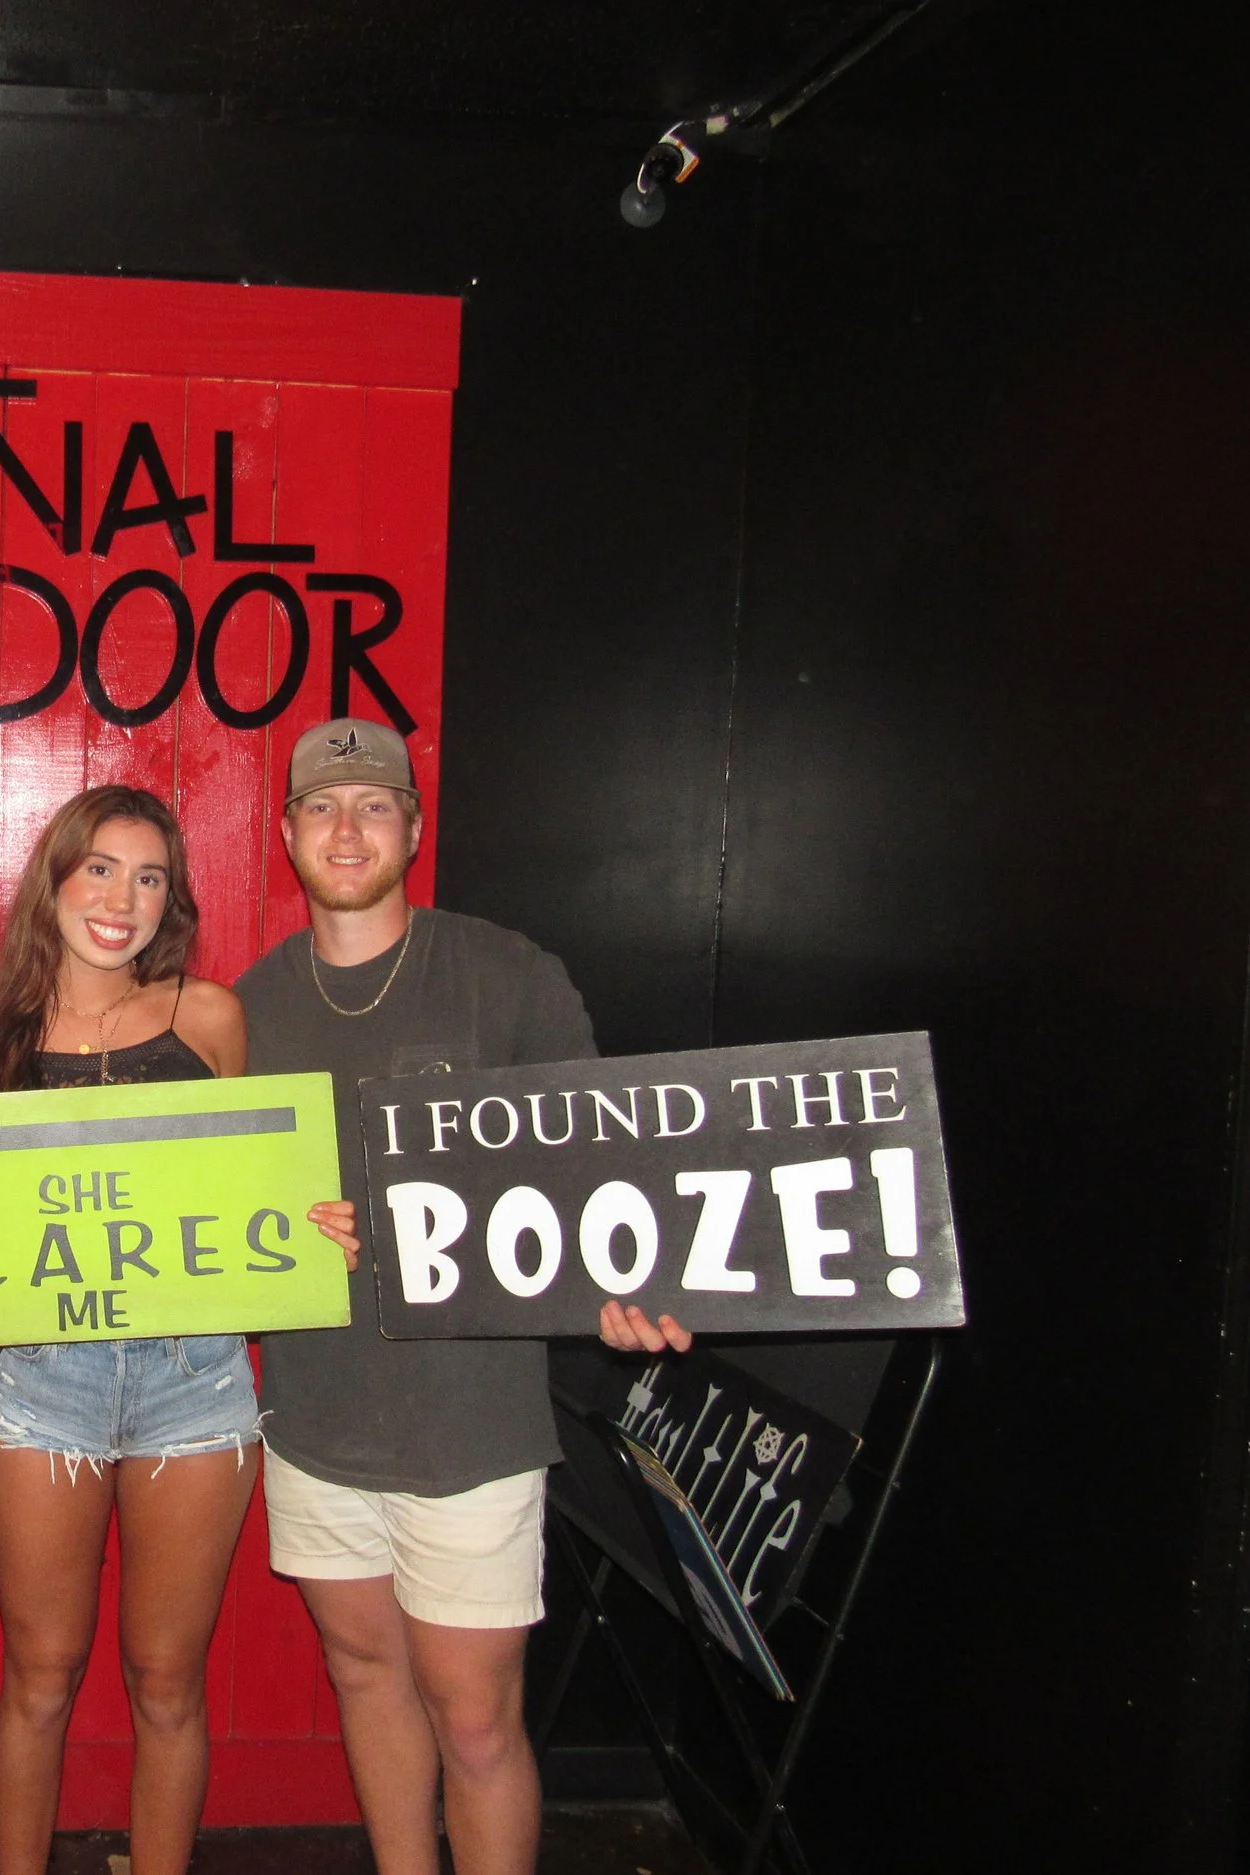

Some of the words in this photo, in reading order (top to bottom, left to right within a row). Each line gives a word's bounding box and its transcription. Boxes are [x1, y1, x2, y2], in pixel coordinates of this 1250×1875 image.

[379, 1104, 406, 1156] I
[424, 1083, 706, 1154] FOUND
[731, 1066, 908, 1131] THE
[38, 1171, 134, 1215] SHE
[385, 1146, 922, 1304] BOOZE!
[56, 1289, 132, 1332] ME
